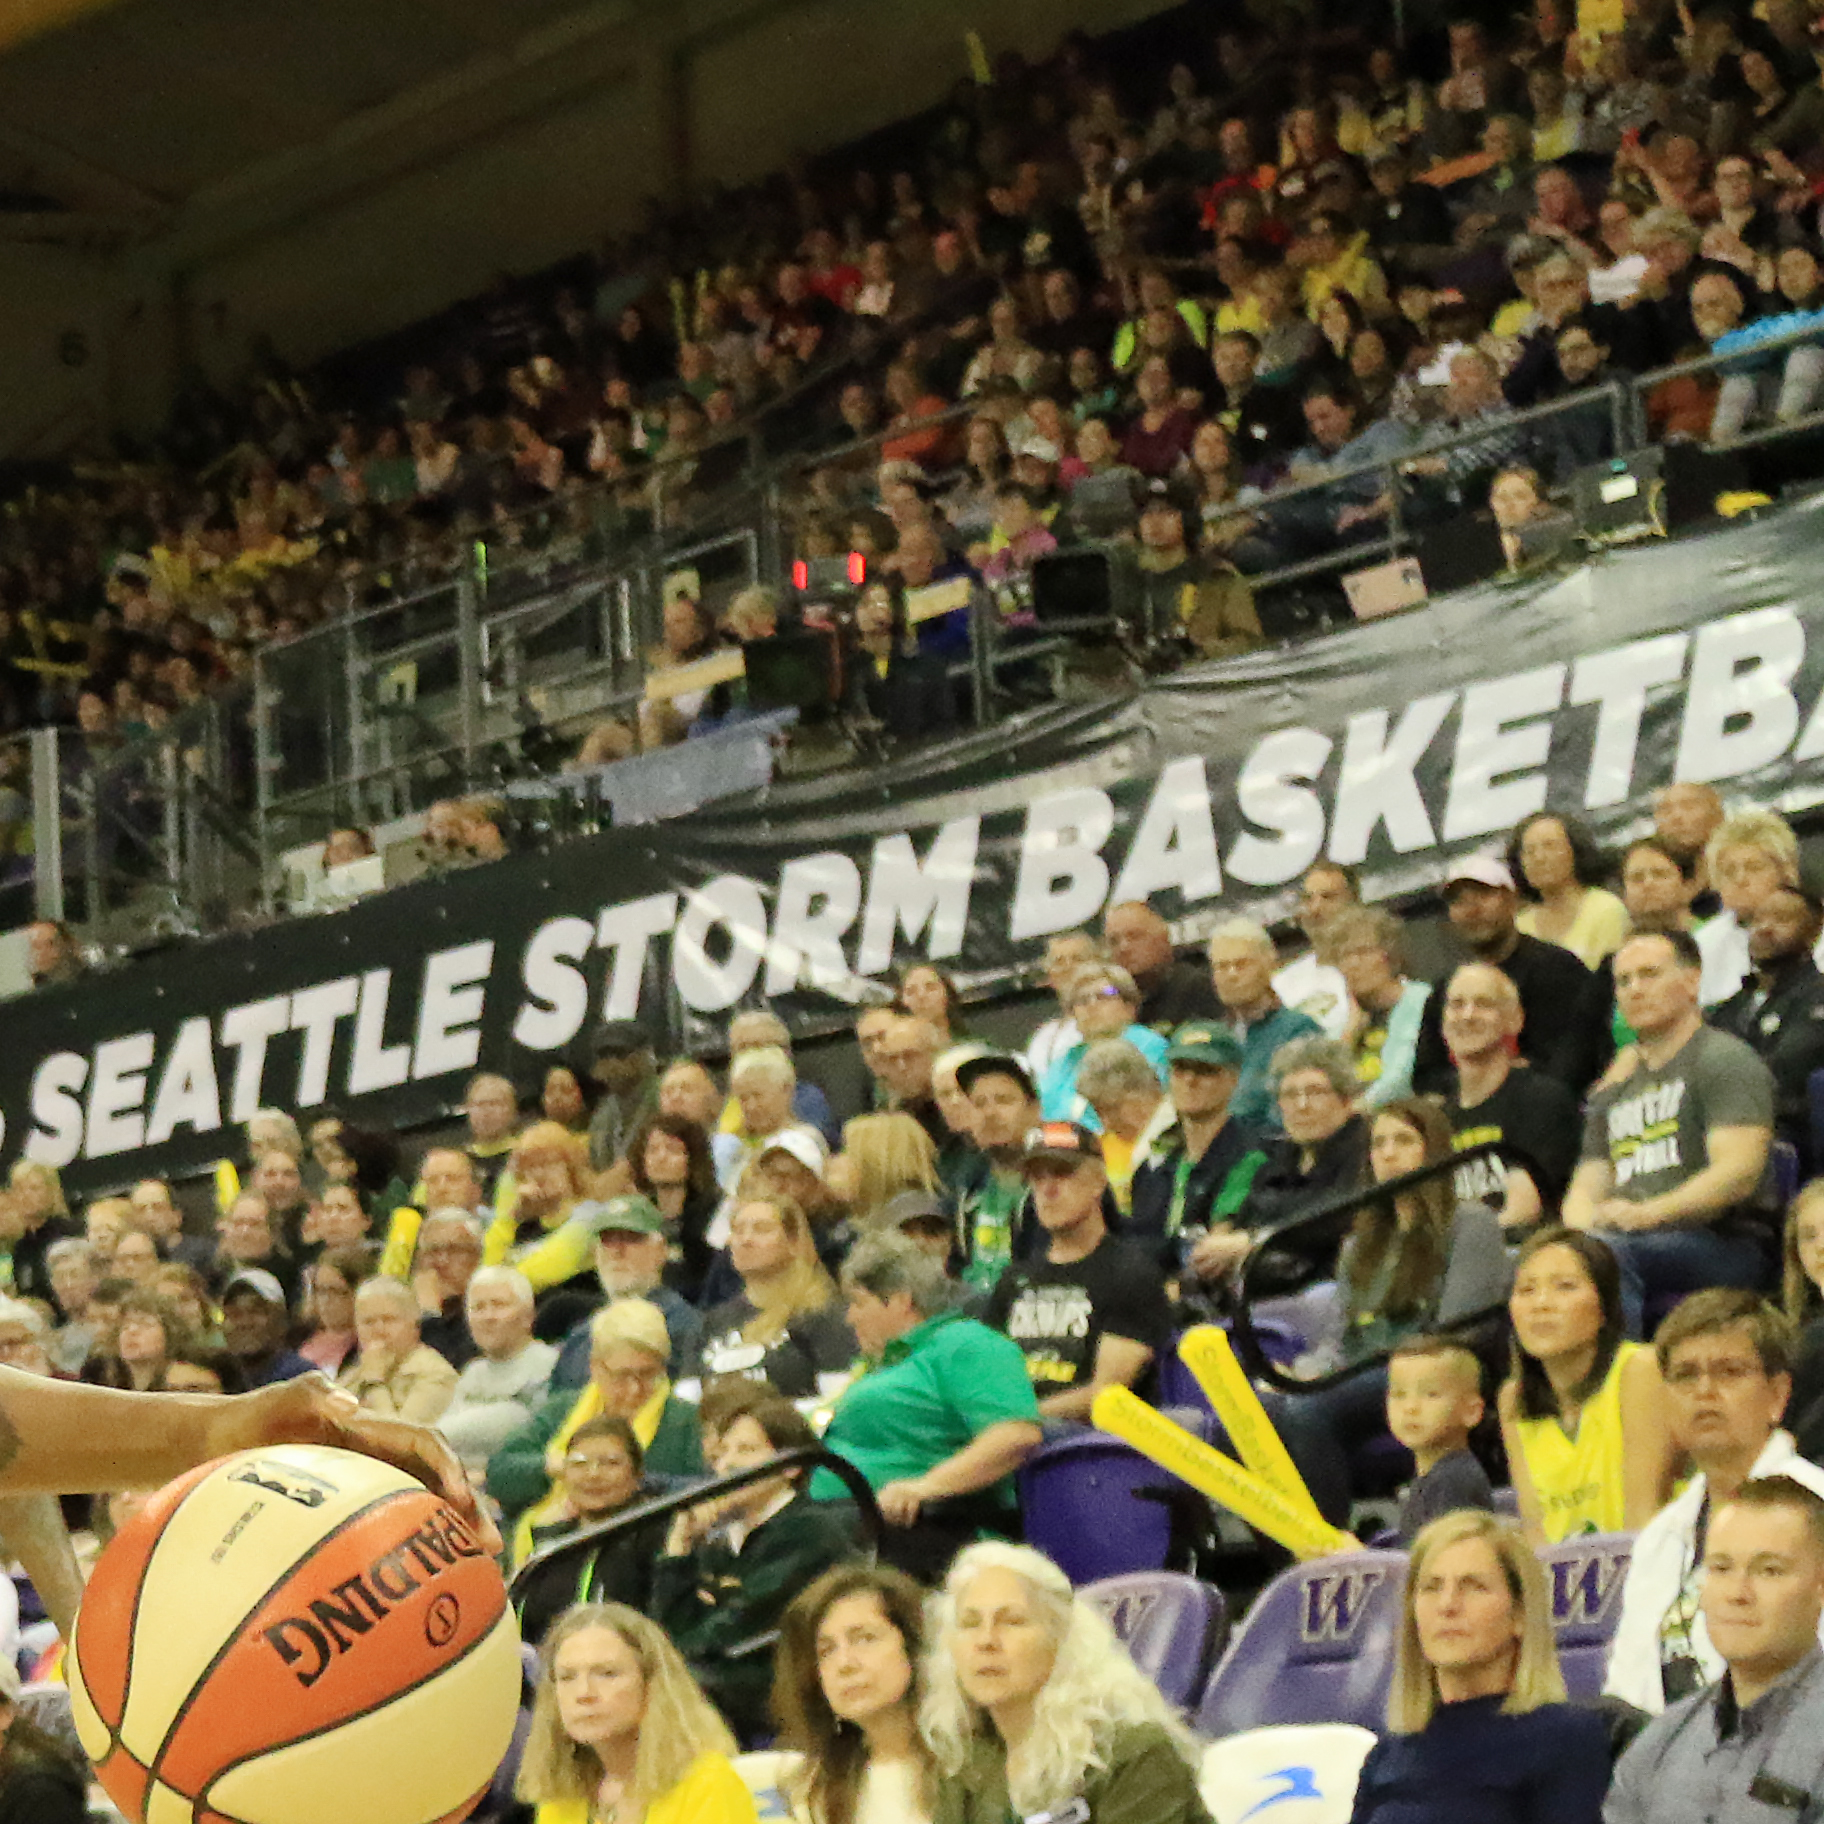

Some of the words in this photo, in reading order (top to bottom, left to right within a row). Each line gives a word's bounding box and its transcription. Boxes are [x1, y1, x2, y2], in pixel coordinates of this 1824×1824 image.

[22, 939, 497, 1168] SEATTLE
[513, 811, 982, 1052] STORM
[1009, 604, 1824, 942] BASKETB
[265, 1506, 488, 1688] PALDING
[1298, 1569, 1388, 1643] W
